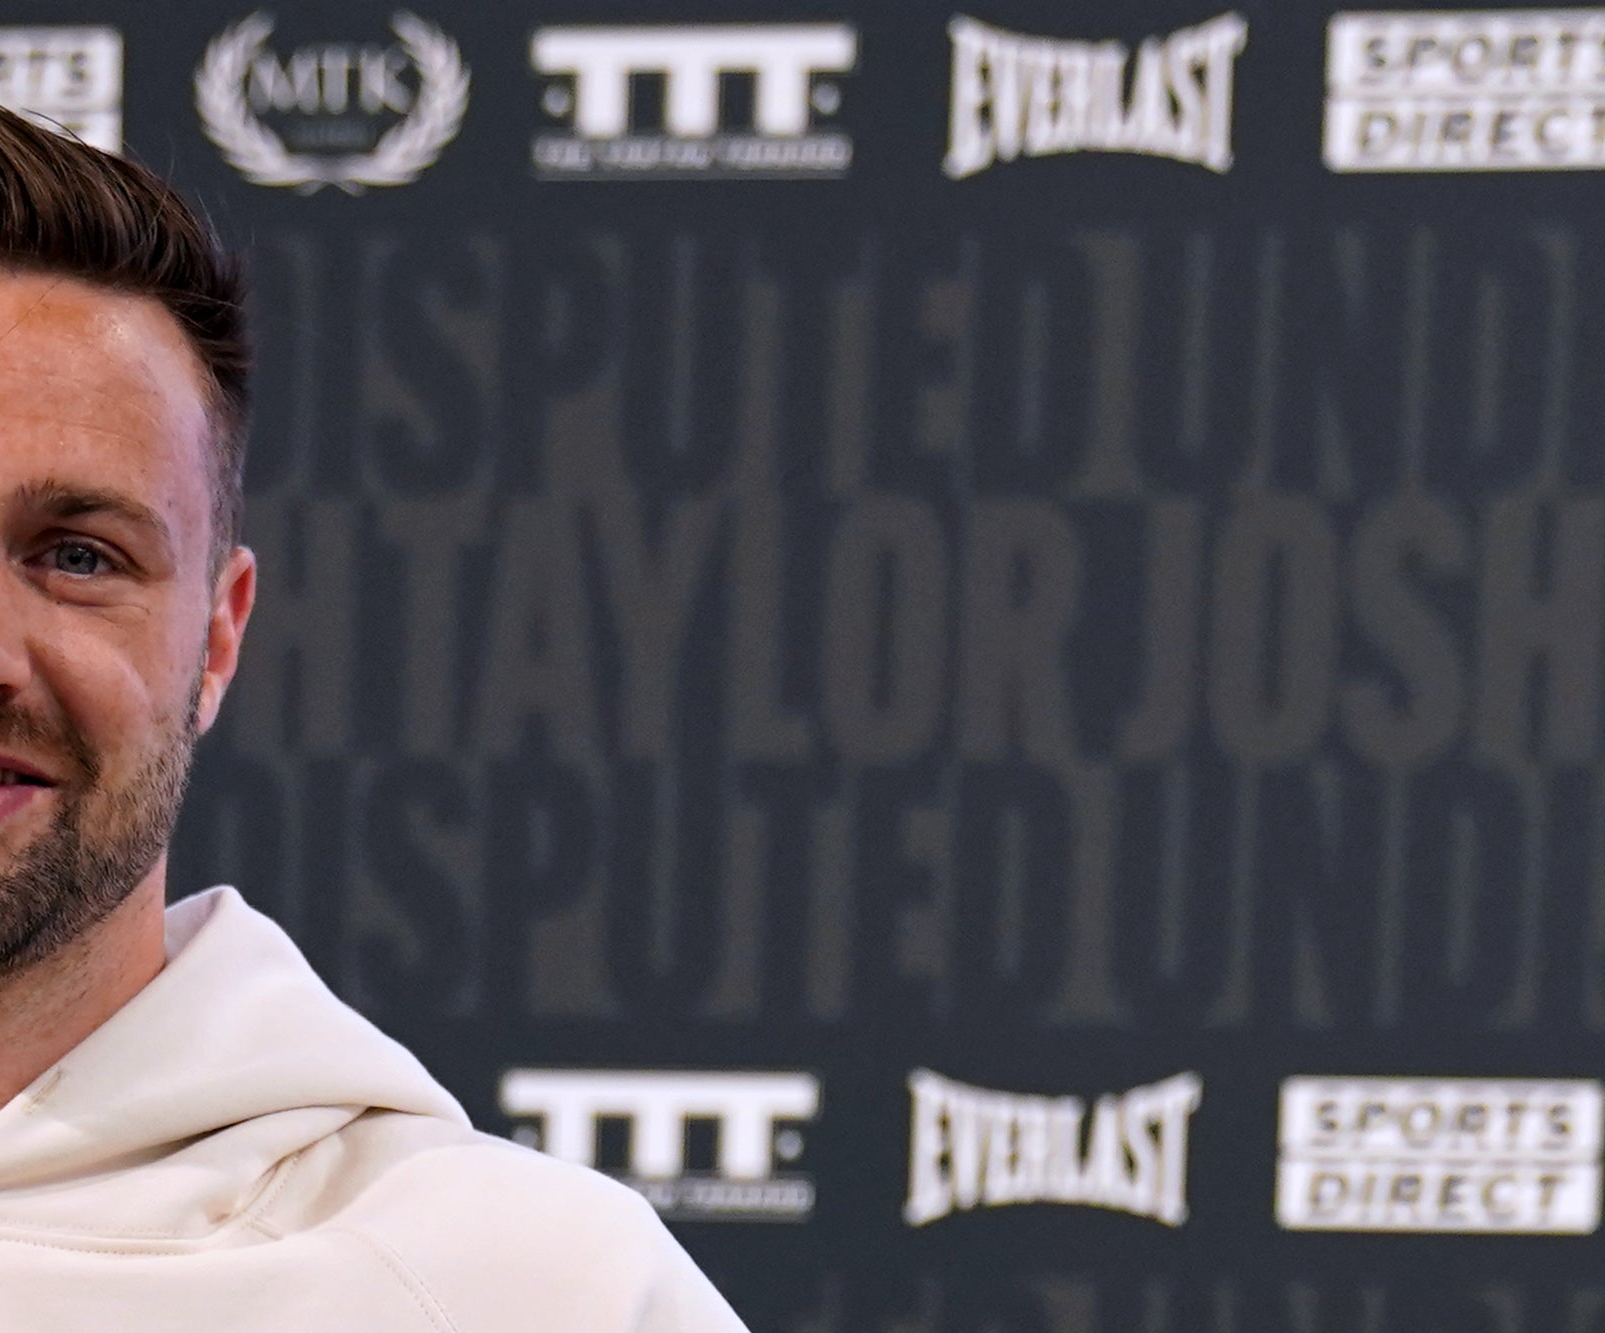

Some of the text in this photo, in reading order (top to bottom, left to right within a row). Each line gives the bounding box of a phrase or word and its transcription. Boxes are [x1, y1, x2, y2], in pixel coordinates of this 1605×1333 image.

[246, 45, 413, 118] MTK
[1358, 32, 1605, 86] SPORT
[942, 12, 1250, 180] EVERLAST
[903, 1068, 1204, 1229] EVERLAST
[1309, 1099, 1575, 1150] SPORTS
[1306, 1171, 1557, 1222] DIRECT
